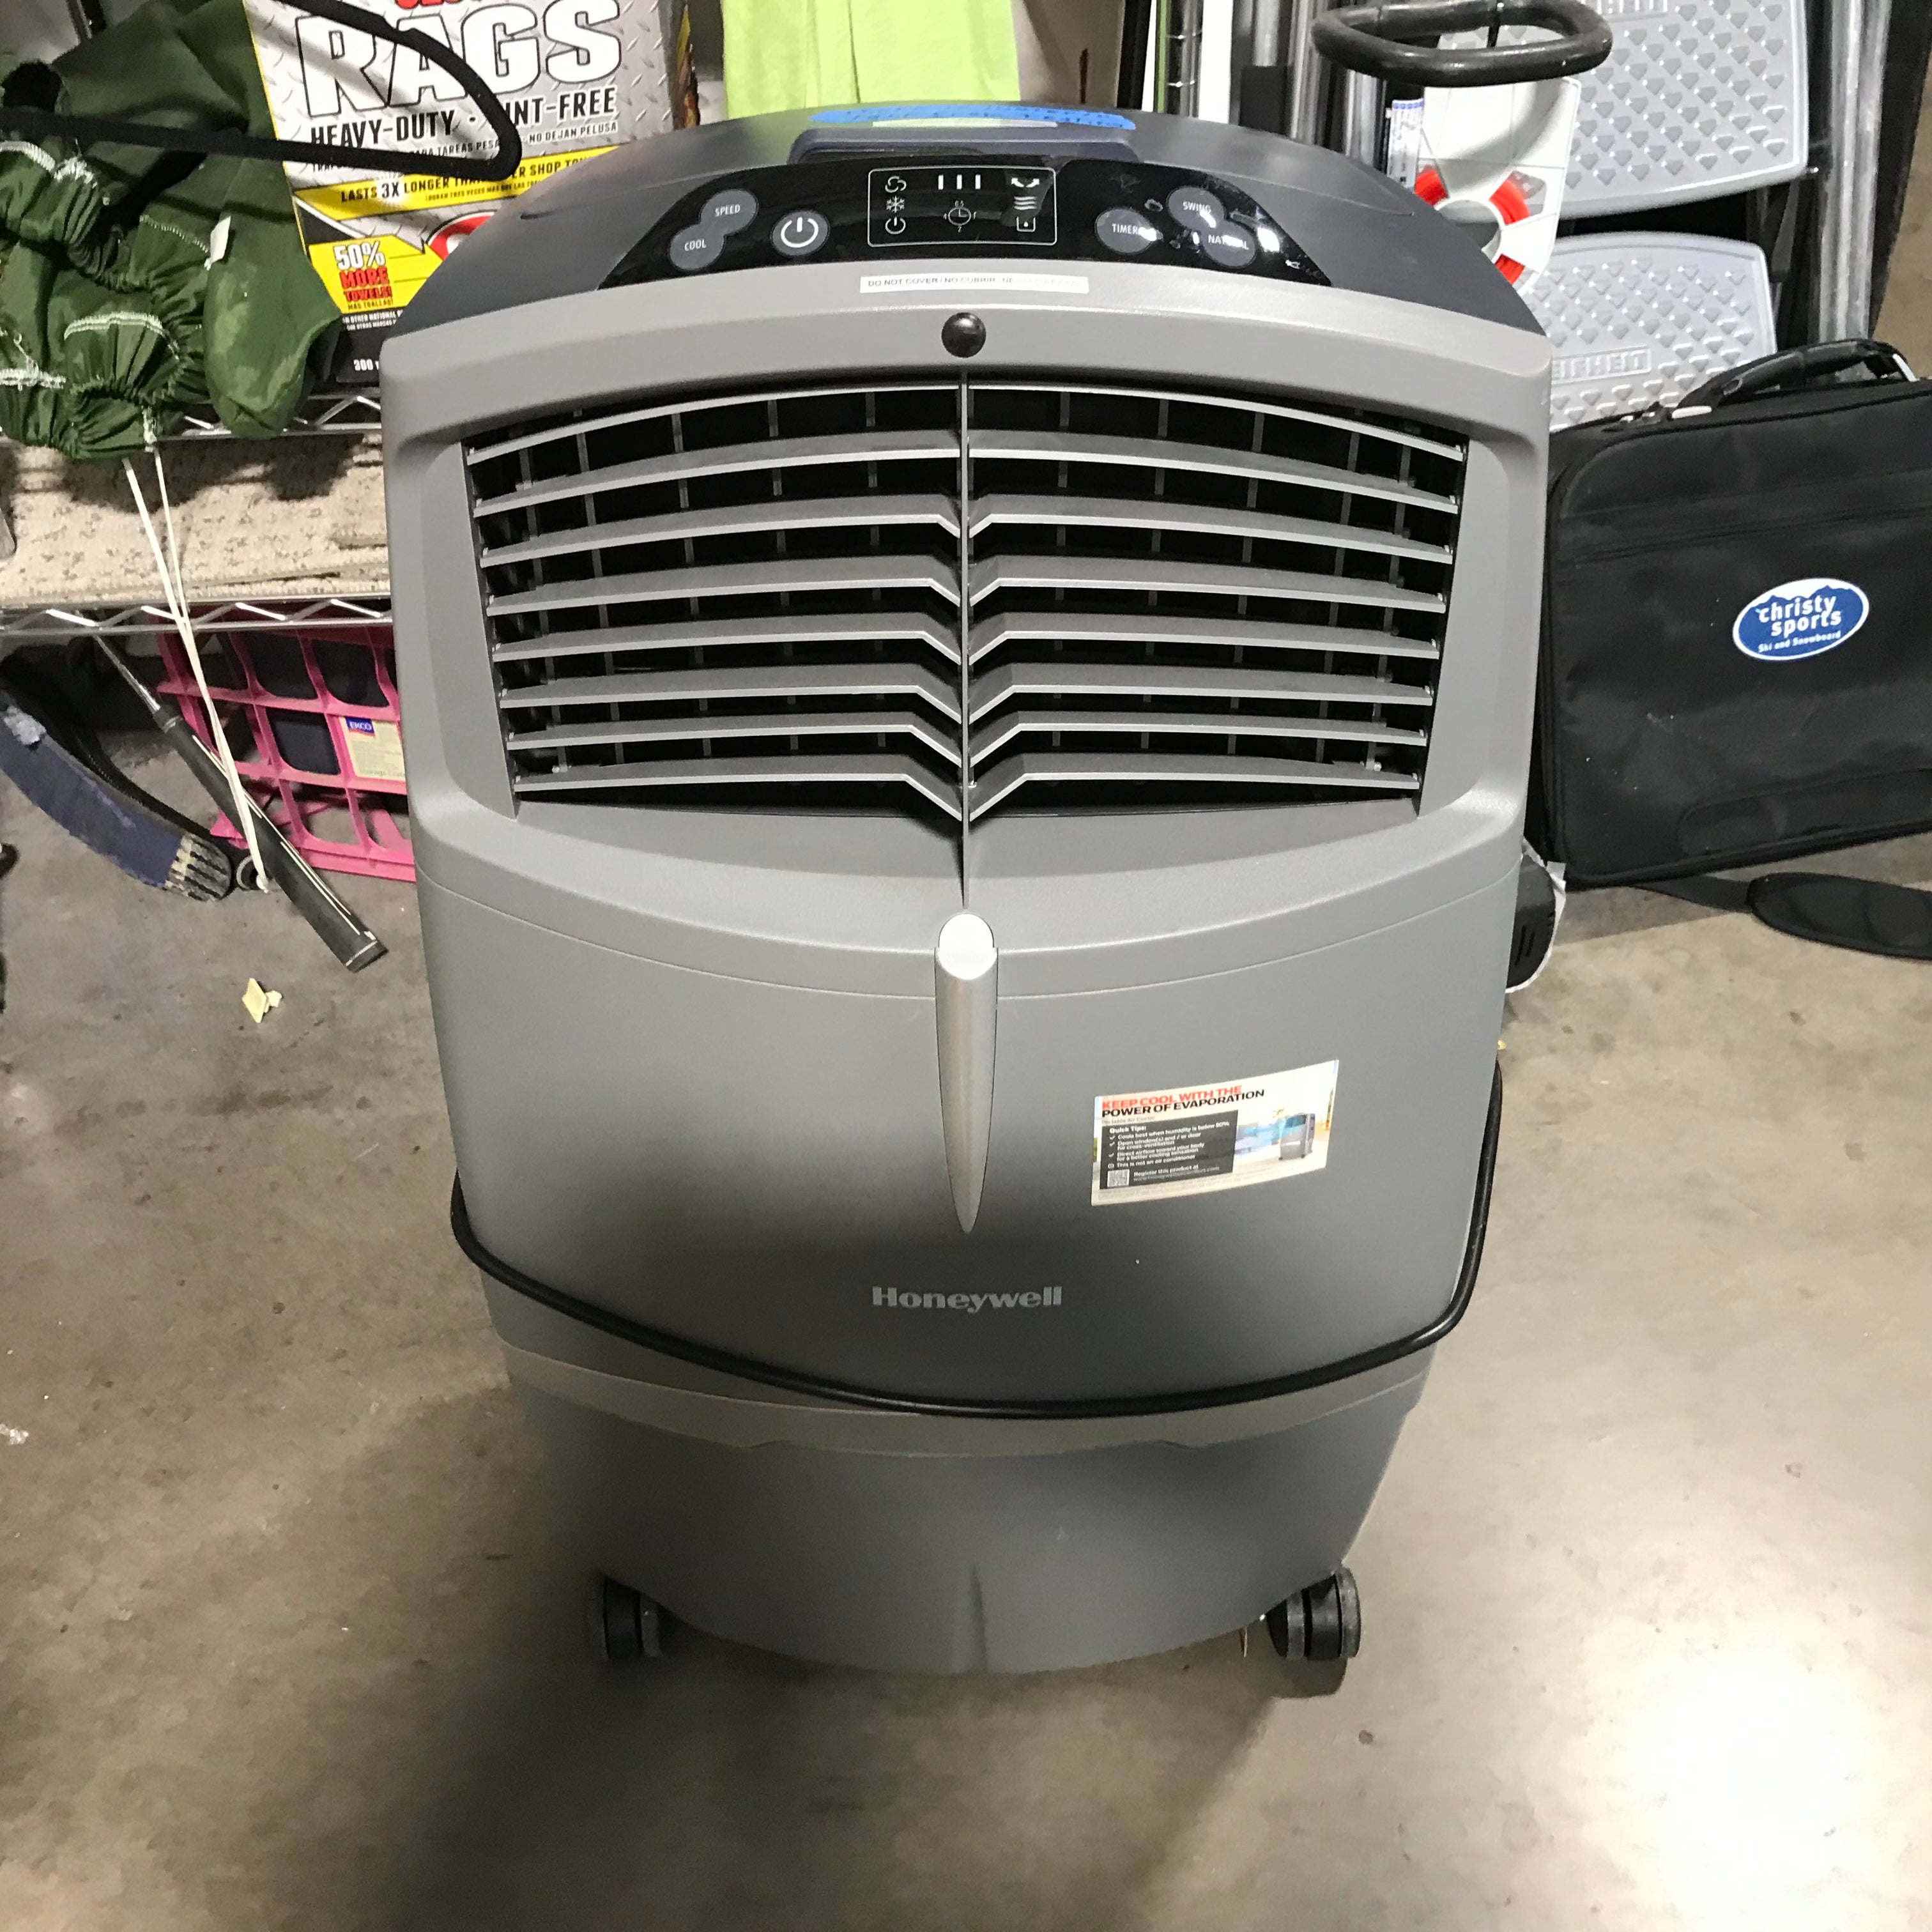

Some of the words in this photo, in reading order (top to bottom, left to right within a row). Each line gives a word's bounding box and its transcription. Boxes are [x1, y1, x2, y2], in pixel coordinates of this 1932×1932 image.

[296, 0, 622, 118] RAGS
[311, 110, 455, 148] HEAVY-DUTY
[503, 88, 615, 126] INT-FREE
[530, 132, 542, 144] NO
[545, 127, 576, 140] DEJAN
[580, 122, 617, 135] PELUSA
[341, 187, 377, 203] LASTS
[381, 181, 399, 199] 3X
[404, 175, 449, 194] LONGER
[530, 162, 561, 176] SHOP
[715, 204, 740, 217] SPEED
[1183, 201, 1211, 214] SWING
[1112, 223, 1138, 235] TIMER
[334, 240, 386, 269] 50%
[684, 239, 707, 252] COOL
[339, 266, 390, 288] MORE
[353, 358, 373, 371] 300
[1758, 595, 1836, 624] christy
[1771, 610, 1841, 638] sports
[1758, 643, 1772, 653] Ski
[1774, 639, 1790, 650] and
[1793, 631, 1841, 647] Snowboard
[1102, 1099, 1137, 1110] KEEP
[1140, 1094, 1176, 1106] COOL
[1179, 1090, 1213, 1102] WITH
[1216, 1085, 1242, 1096] THE
[1102, 1106, 1151, 1117] POWER
[1153, 1103, 1171, 1112] OF
[1174, 1089, 1264, 1110] EVAPORATION
[872, 1285, 1056, 1314] Honeywell
